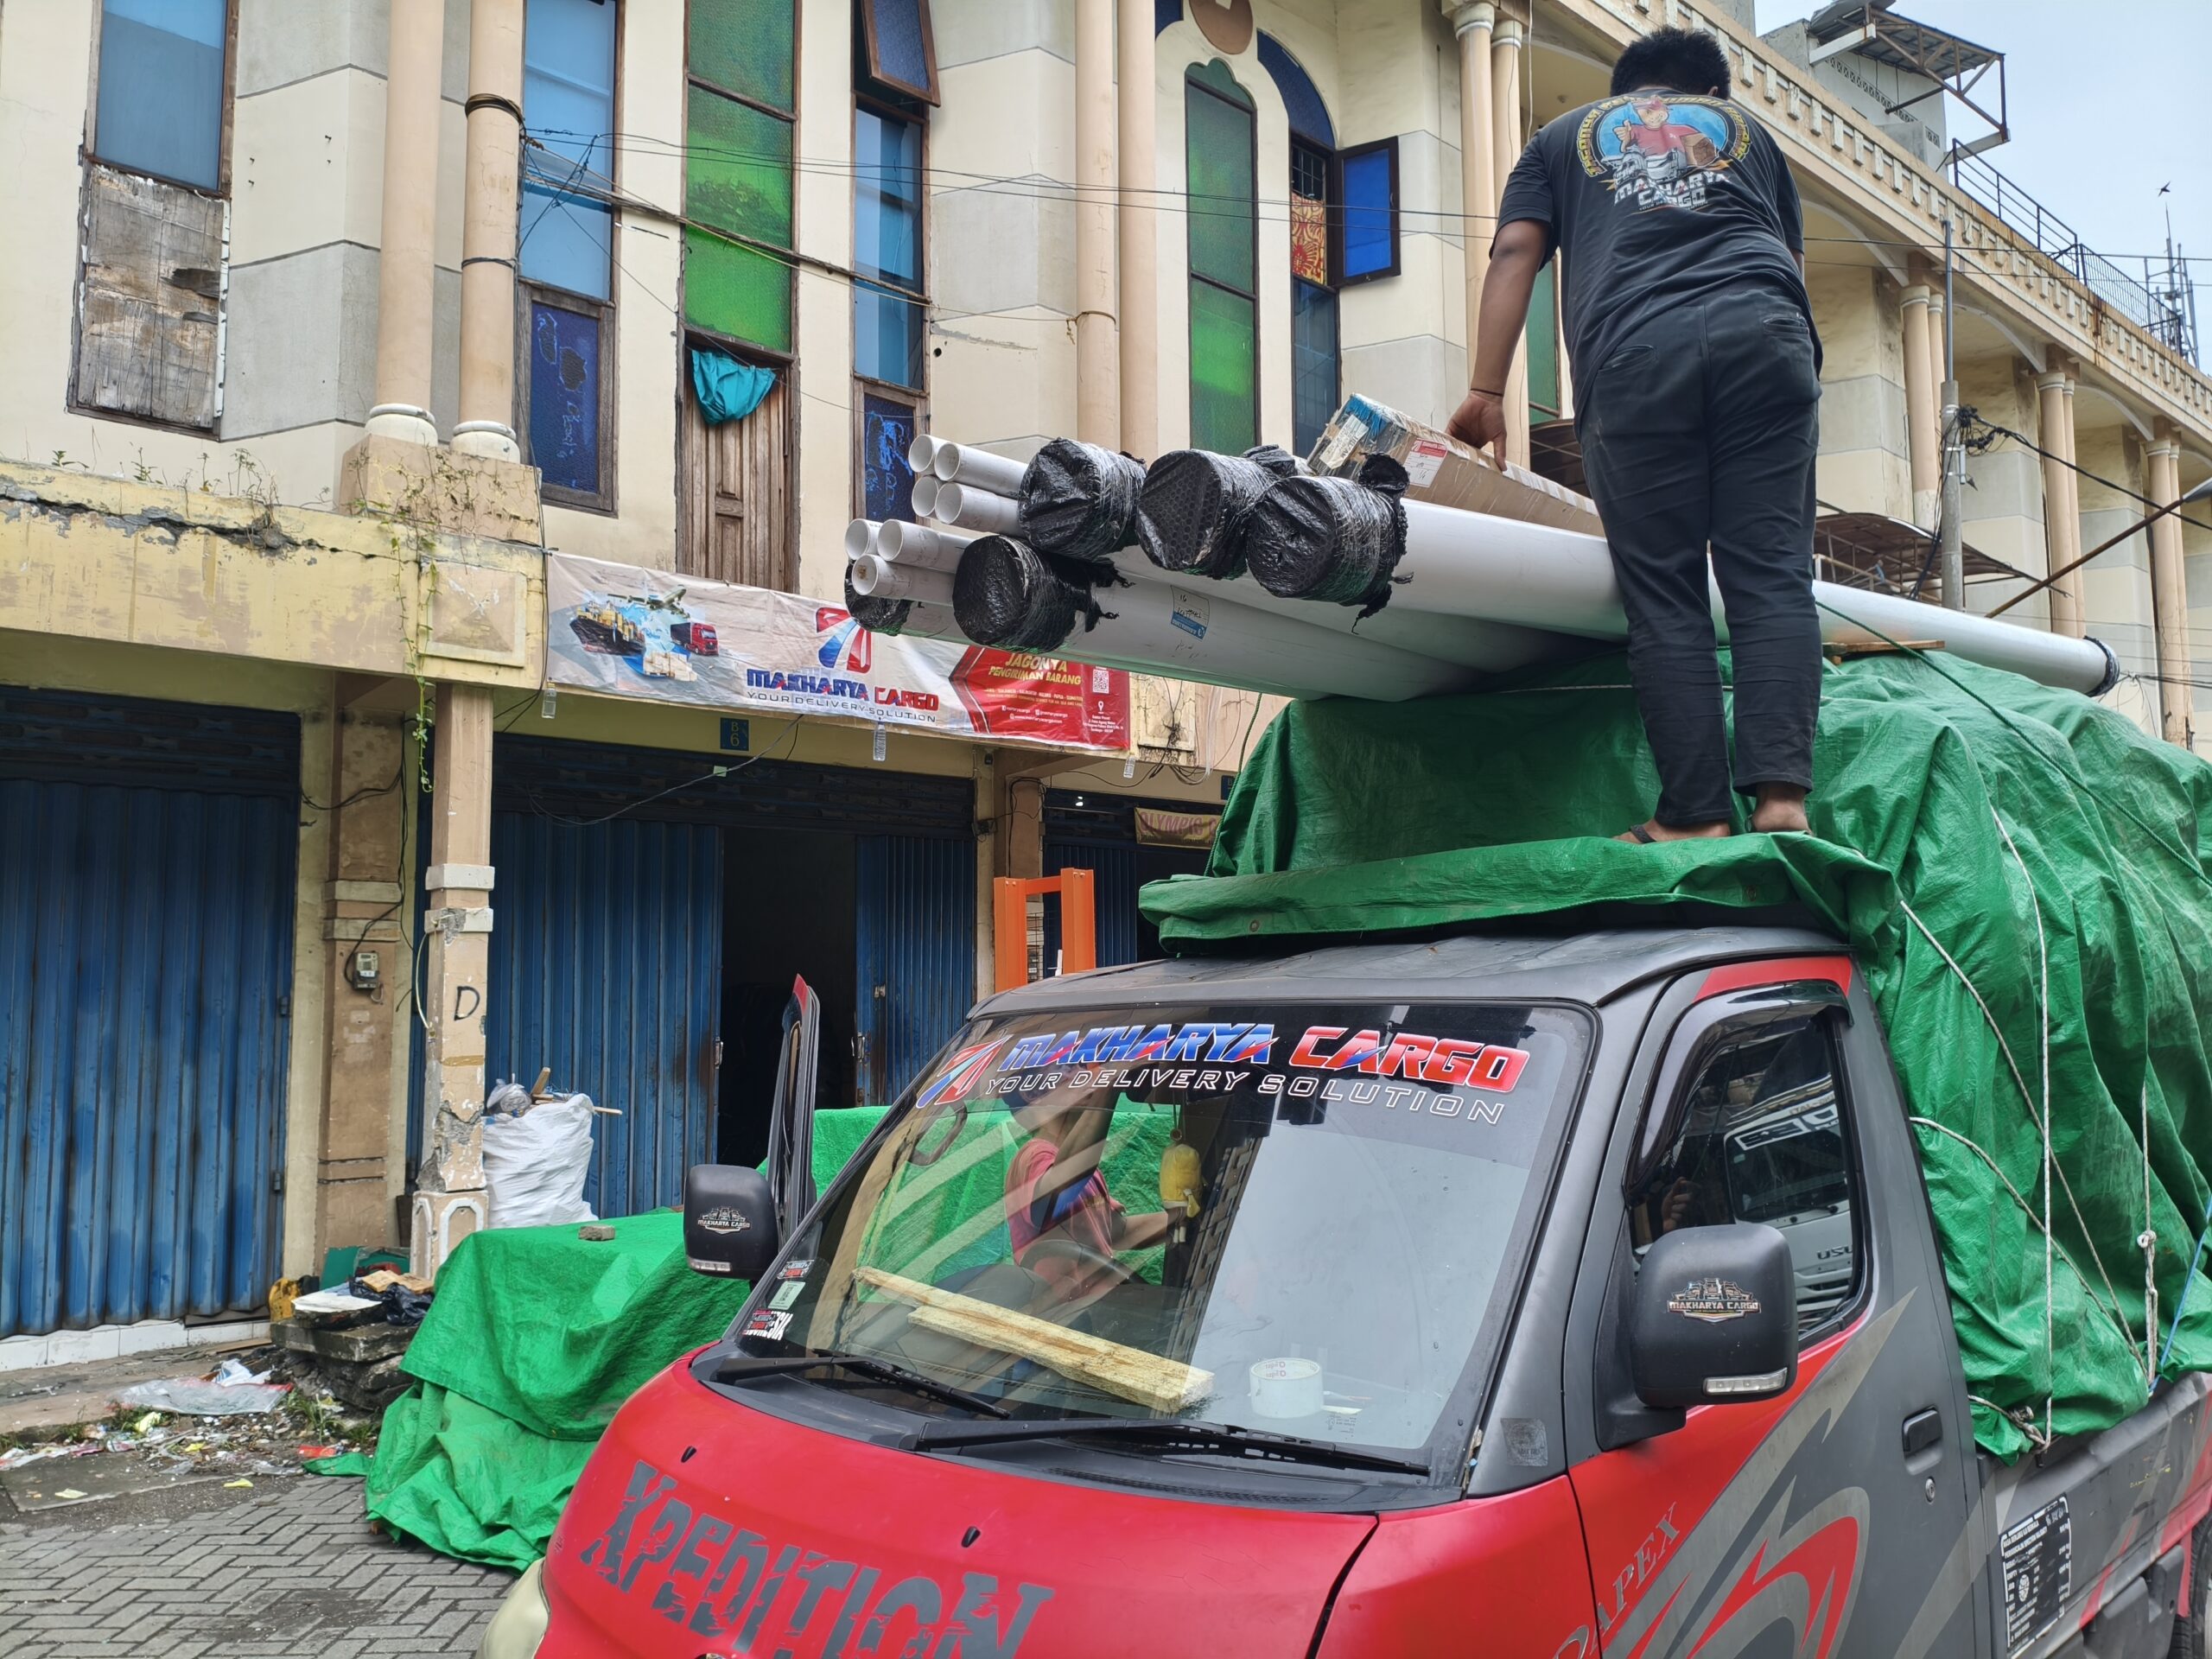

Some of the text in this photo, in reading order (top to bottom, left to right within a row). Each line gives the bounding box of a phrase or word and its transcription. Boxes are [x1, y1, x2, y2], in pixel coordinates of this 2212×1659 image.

[988, 666, 1082, 685] PENGIRIMAN BARANG
[1005, 653, 1068, 672] JAGONYA
[747, 668, 939, 711] MAKHARYA CARGO
[747, 691, 937, 723] YOUR DELIVERY SOLUTION
[730, 732, 741, 747] 6
[454, 985, 480, 1021] D
[997, 1022, 1530, 1094] MAKHARYA CARGO
[985, 1069, 1505, 1126] YOUR DELIVERY SOLUTION
[1669, 1301, 1758, 1310] MAKHARYA CARGO
